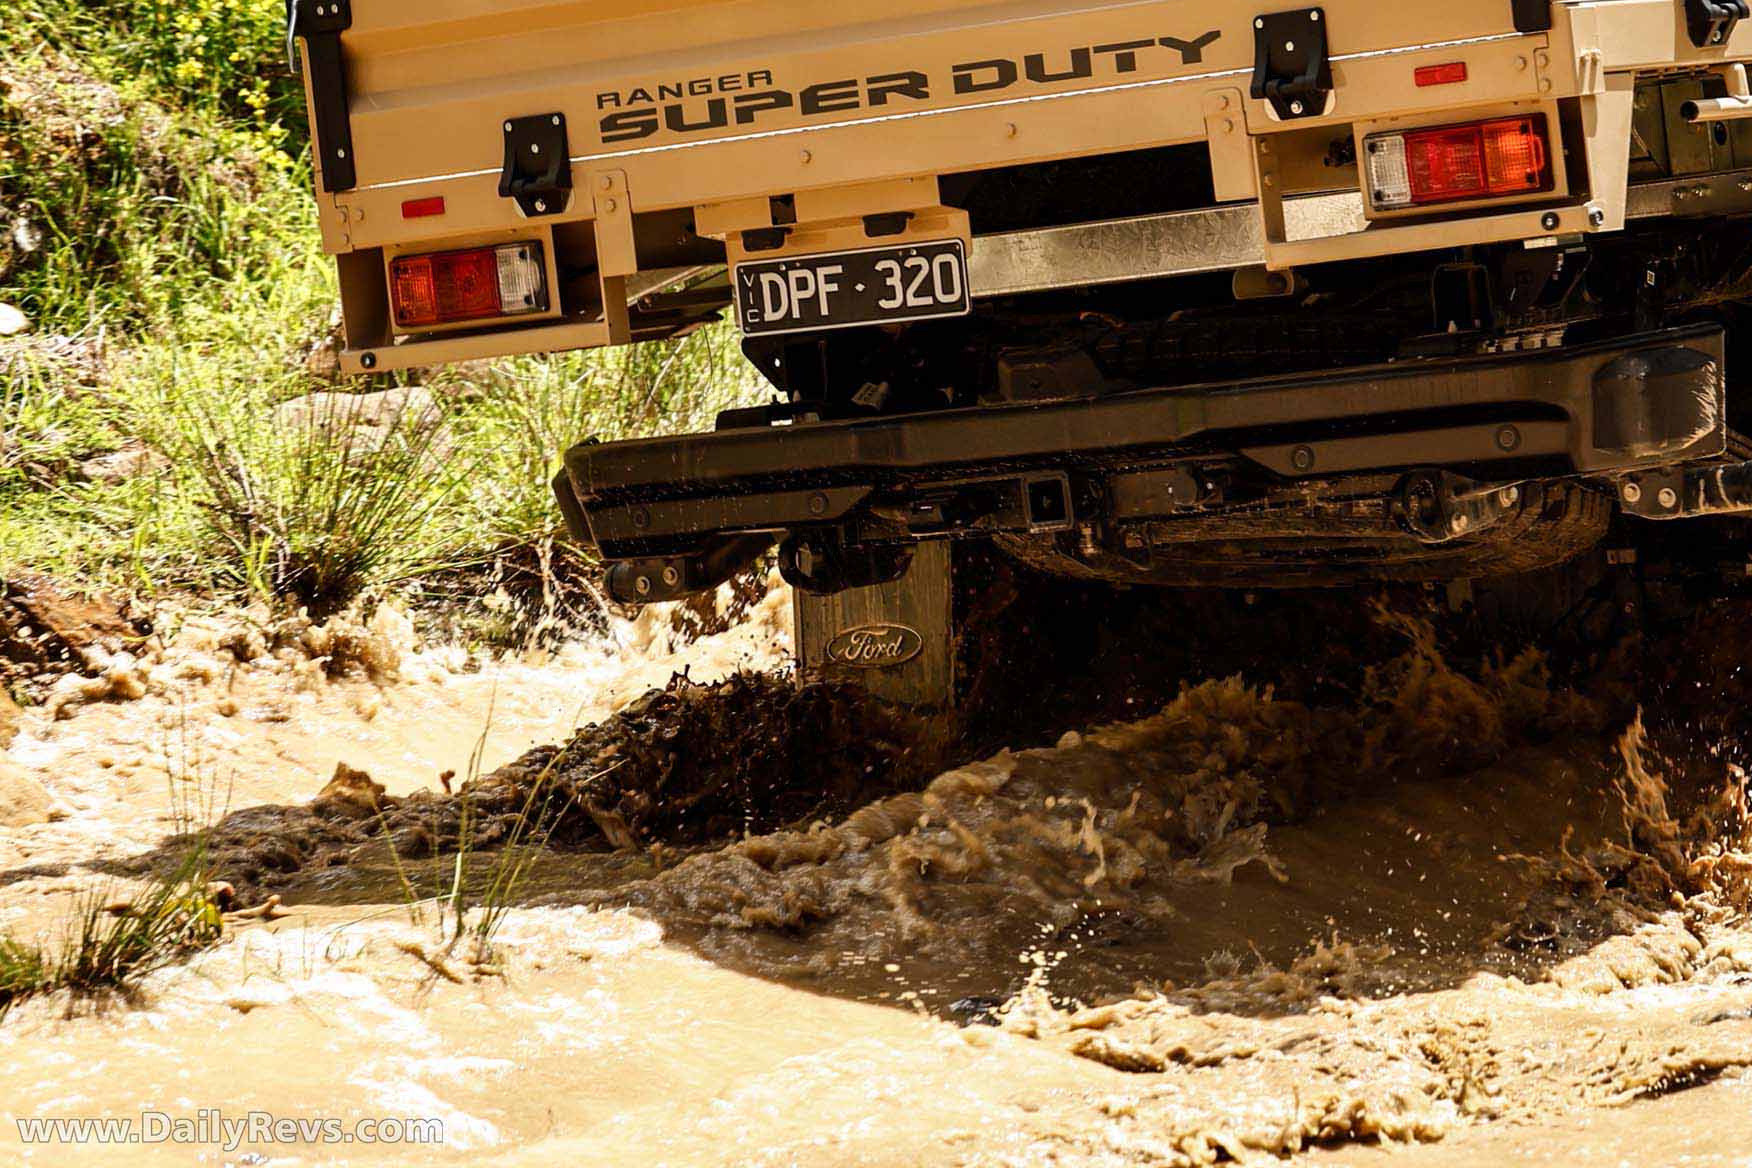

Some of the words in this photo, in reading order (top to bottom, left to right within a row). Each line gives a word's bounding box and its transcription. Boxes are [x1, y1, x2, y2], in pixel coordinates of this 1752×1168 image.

[596, 70, 773, 110] RANGER
[599, 70, 930, 144] SUPER
[951, 30, 1222, 95] DUTY
[742, 272, 761, 323] VIC
[759, 264, 843, 322] DPF
[874, 253, 962, 309] 320
[843, 629, 904, 660] Ford
